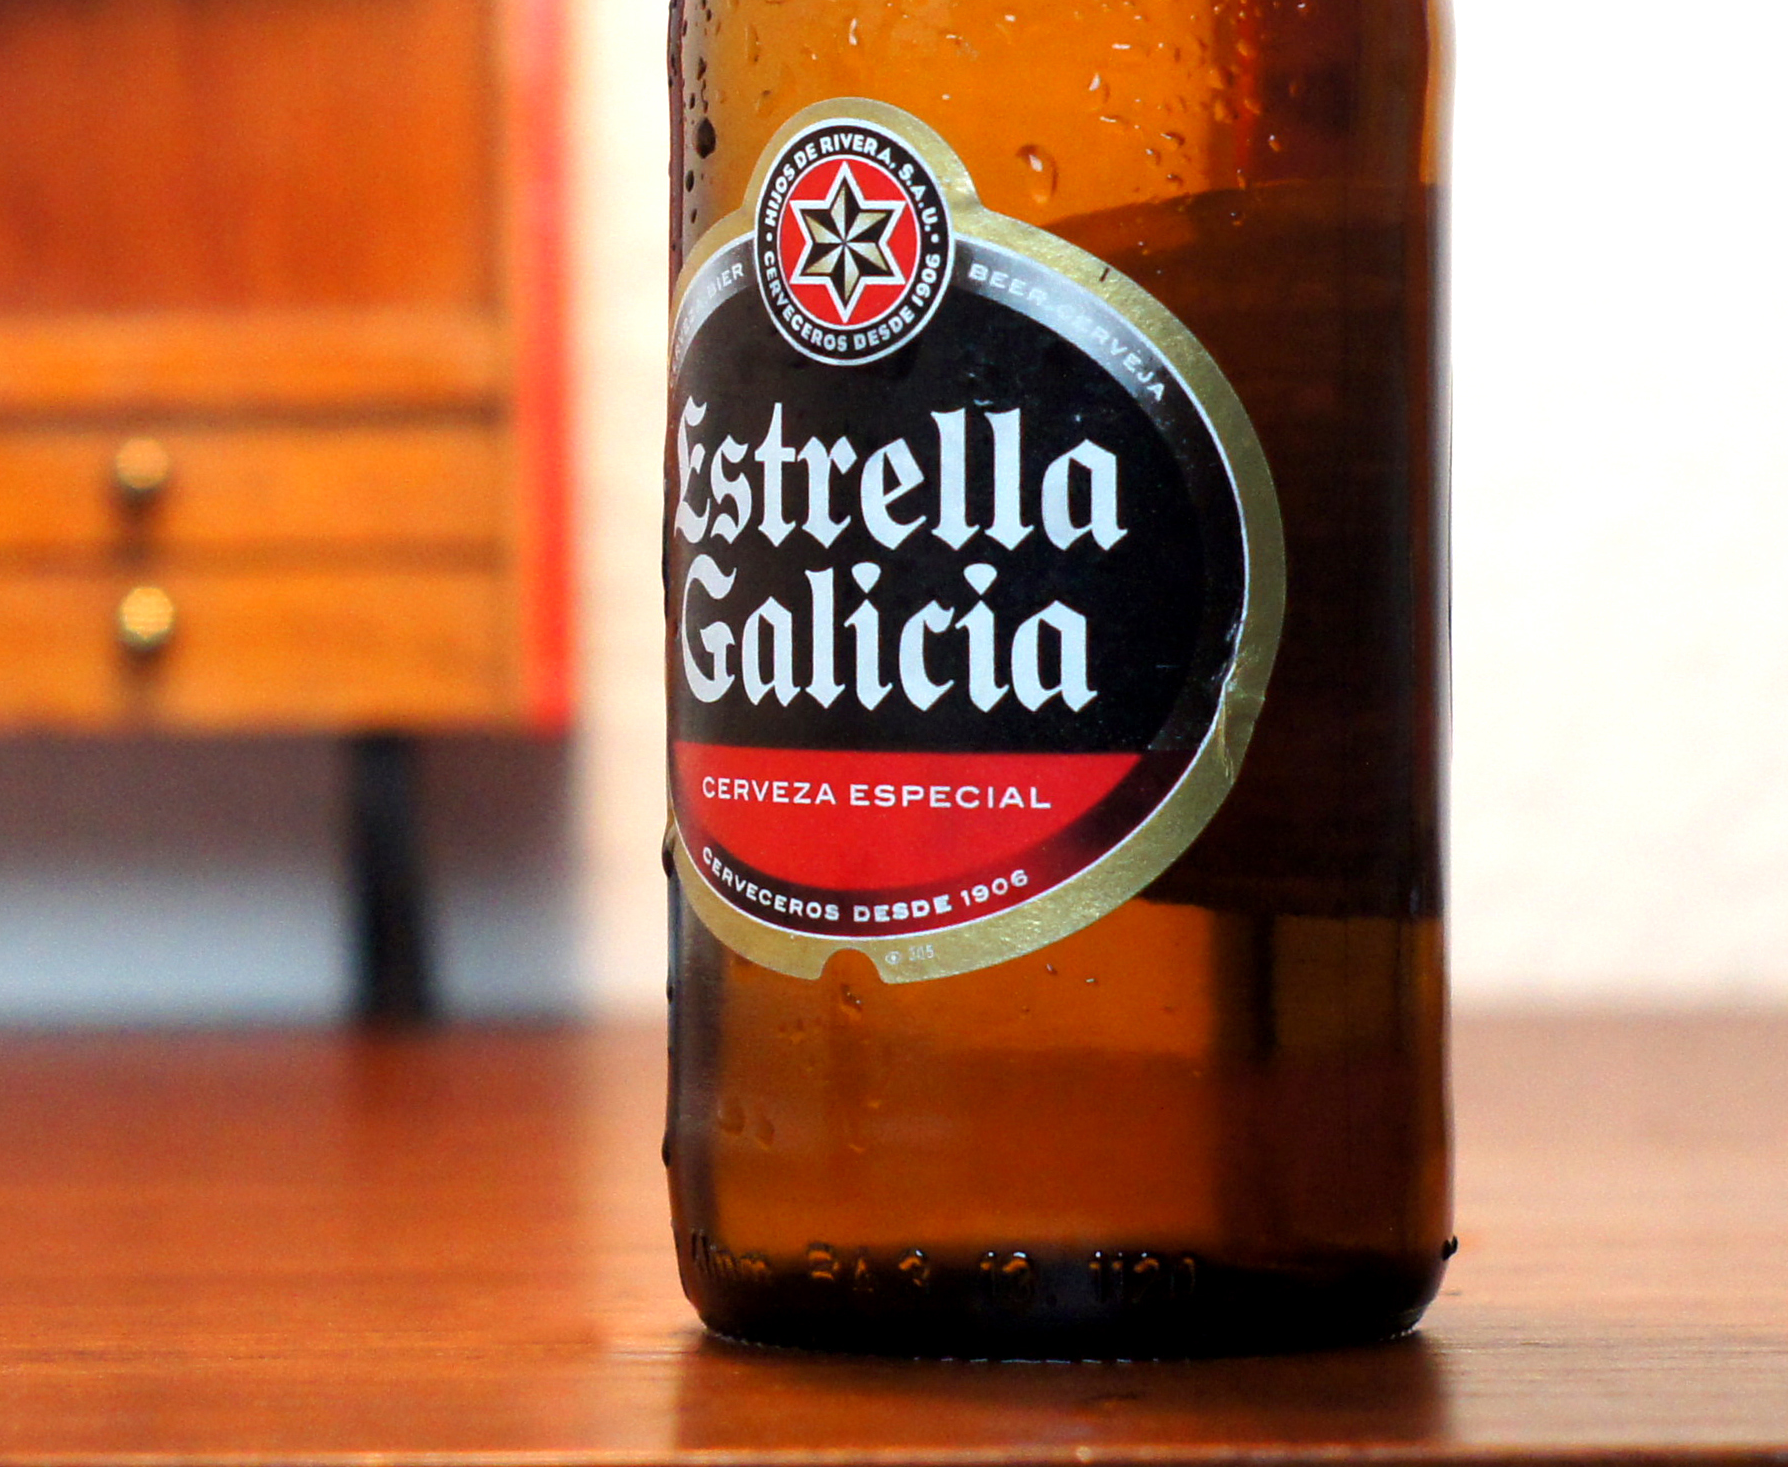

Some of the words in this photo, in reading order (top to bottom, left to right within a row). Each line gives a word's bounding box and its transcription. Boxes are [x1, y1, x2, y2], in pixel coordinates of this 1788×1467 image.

[764, 164, 795, 227] HIJOS
[793, 143, 818, 170] DE
[898, 163, 939, 232] S.A.U.
[764, 251, 847, 352] CERVECEROS
[854, 306, 915, 351] DESDE
[911, 253, 941, 308] 1906
[968, 262, 1049, 306] BEER
[674, 395, 1128, 551] Estrella
[681, 553, 1099, 714] Galicia
[702, 776, 837, 805] CERVEZA
[849, 784, 1052, 809] ESPECIAL
[702, 846, 840, 922] CERVECEROS
[853, 894, 953, 923] DESDE
[960, 869, 1030, 907] 1906
